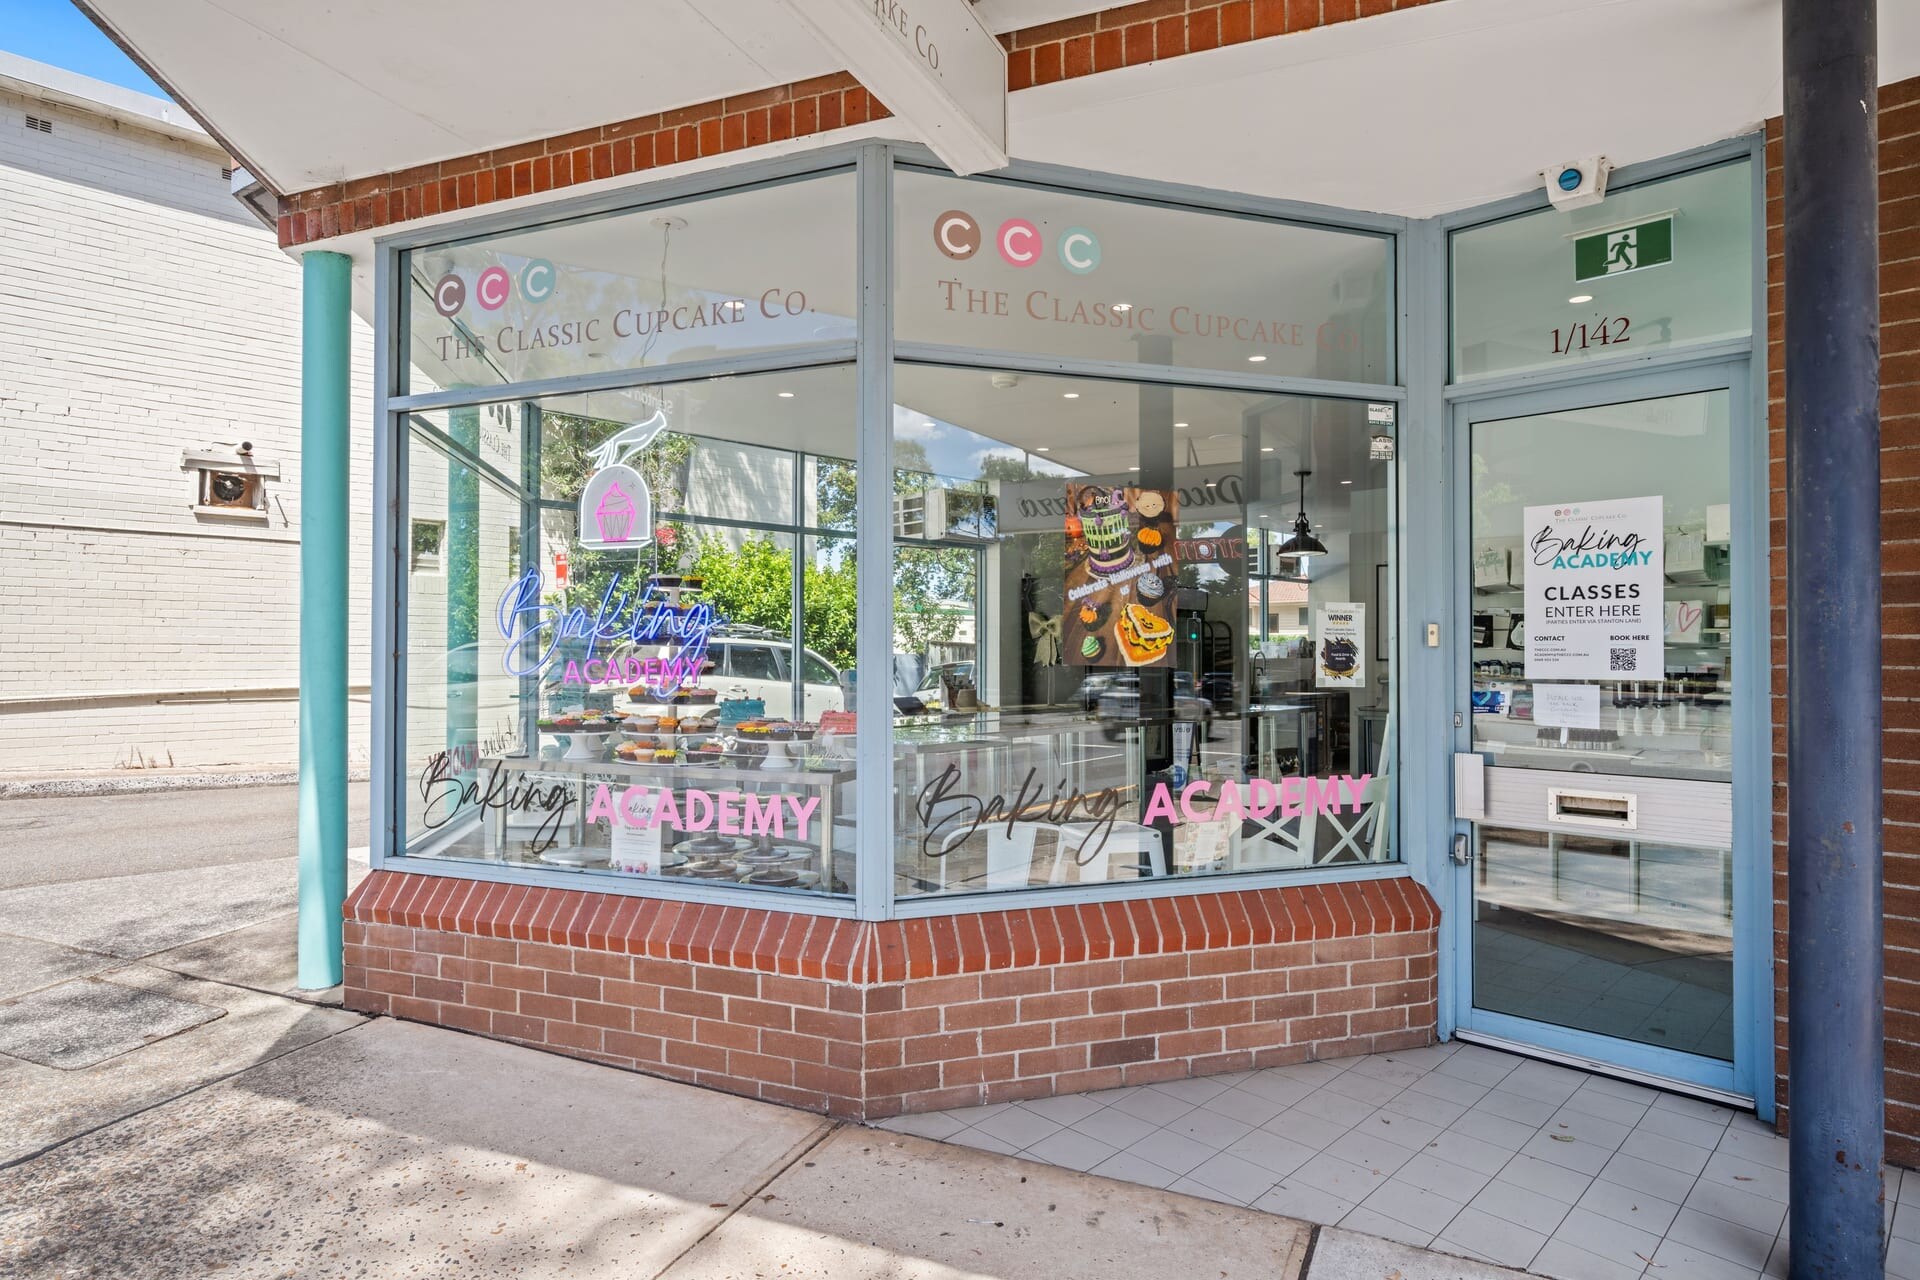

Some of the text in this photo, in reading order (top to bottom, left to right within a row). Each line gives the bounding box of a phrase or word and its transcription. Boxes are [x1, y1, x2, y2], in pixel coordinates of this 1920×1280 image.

[436, 287, 816, 362] THE CLASSIC CUPCAKE CO.
[938, 279, 1010, 317] THE
[1026, 291, 1154, 332] CLASSIC
[1169, 306, 1304, 347] CUPCAKE
[1550, 315, 1631, 355] 1/142
[1531, 525, 1647, 570] Baking
[1552, 550, 1653, 570] ACADEMY
[1109, 563, 1151, 585] Halloween
[1152, 553, 1173, 569] with
[1544, 583, 1640, 601] CLASSES
[1545, 604, 1641, 618] ENTER HERE
[497, 568, 724, 699] Baking
[563, 656, 707, 686] ACADEMY
[420, 751, 821, 854] Baking ACADEMY
[914, 763, 1373, 867] Baking ACADEMY
